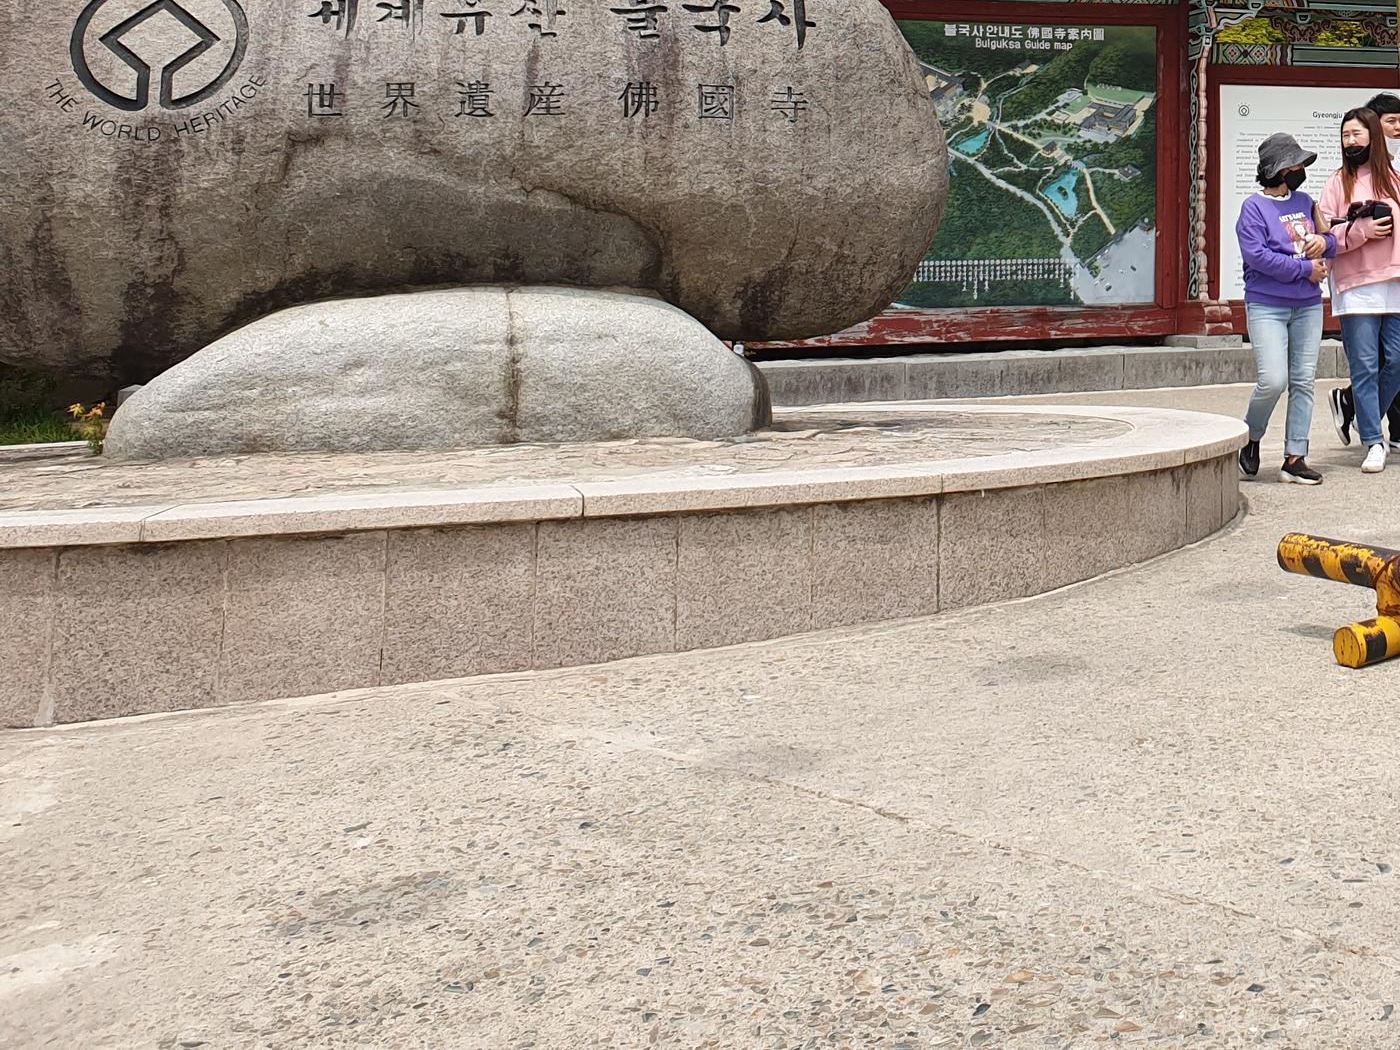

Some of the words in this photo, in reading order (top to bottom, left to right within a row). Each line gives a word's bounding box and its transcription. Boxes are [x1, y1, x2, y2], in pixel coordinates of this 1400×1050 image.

[975, 37, 1021, 49] Bulguksa
[1024, 39, 1051, 50] Guide
[1053, 41, 1073, 52] map
[45, 77, 80, 113] THE
[82, 111, 161, 141] WORLD
[174, 74, 266, 137] HERITAGE
[1312, 110, 1343, 119] Gyeongju
